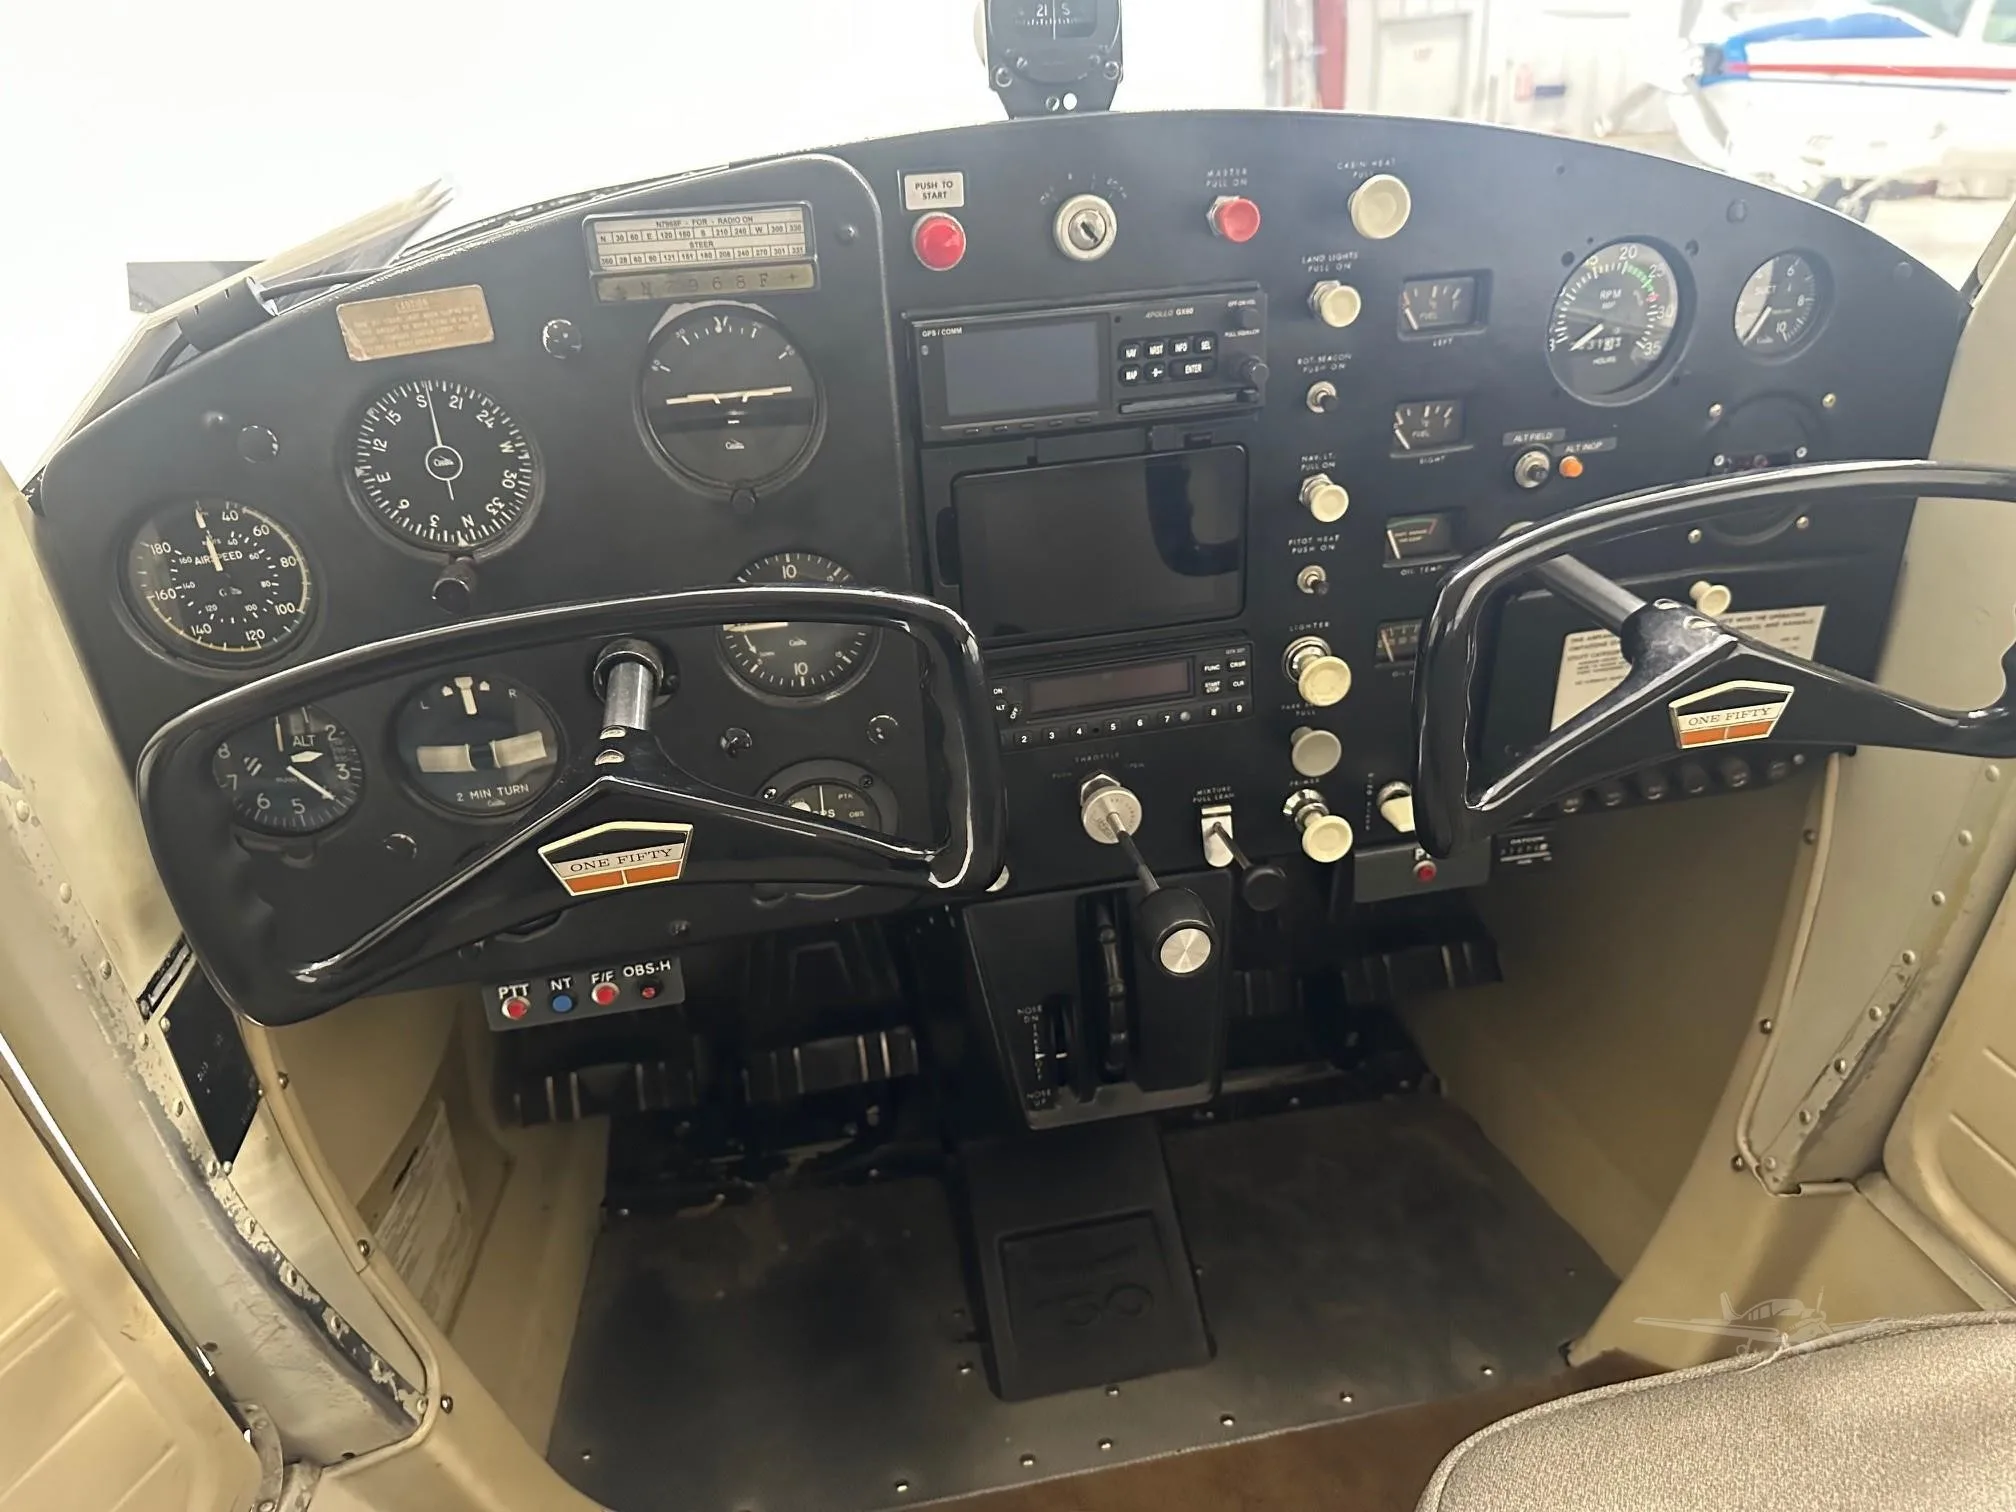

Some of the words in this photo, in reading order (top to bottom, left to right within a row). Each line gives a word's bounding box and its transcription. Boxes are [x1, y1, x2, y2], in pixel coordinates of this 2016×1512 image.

[1037, 4, 1047, 17] 21
[1062, 4, 1070, 15] S
[915, 181, 938, 190] PUSH
[942, 180, 953, 188] TO
[1206, 179, 1227, 188] PULL
[1233, 178, 1248, 186] ON
[923, 191, 947, 200] START
[717, 216, 740, 225] RADIO
[690, 240, 714, 249] STEER
[1302, 254, 1325, 264] LAND
[1329, 252, 1358, 261] LIGHTS
[1619, 247, 1638, 260] 20
[1336, 262, 1351, 270] ON
[1648, 264, 1665, 279] 25
[1787, 265, 1795, 276] 6
[1600, 290, 1621, 300] RPM
[1798, 294, 1804, 306] 8
[1146, 309, 1173, 318] APOLLO
[922, 329, 936, 337] GPS
[942, 327, 962, 335] COMM
[1776, 321, 1787, 333] 10
[1175, 342, 1187, 352] INFO
[1644, 342, 1662, 356] 35
[1185, 364, 1202, 374] ENTER
[416, 395, 427, 407] S
[449, 395, 463, 410] 21
[385, 410, 401, 426] 15
[476, 410, 493, 428] 24
[1513, 433, 1528, 442] ALT
[1530, 432, 1553, 440] FIELD
[372, 438, 387, 452] 12
[500, 440, 514, 453] W
[1565, 444, 1580, 453] ALT
[377, 472, 391, 483] E
[502, 470, 517, 489] 30
[485, 497, 504, 515] 33
[222, 511, 238, 521] 40
[429, 515, 440, 527] 3
[461, 514, 474, 527] N
[253, 525, 270, 535] 60
[150, 542, 171, 554] 180
[1292, 546, 1315, 554] PUSH
[195, 551, 243, 565] AIREED
[280, 557, 297, 567] 80
[782, 565, 797, 579] 10
[155, 588, 177, 600] 160
[274, 603, 296, 615] 100
[191, 624, 212, 635] 140
[245, 629, 265, 641] 120
[794, 662, 808, 675] 10
[1204, 664, 1220, 672] FUNC
[509, 689, 517, 698] R
[420, 702, 430, 710] L
[1689, 715, 1720, 726] ONE
[1725, 708, 1772, 720] FIFTY
[1021, 735, 1027, 743] 2
[1165, 715, 1170, 723] 7
[1237, 704, 1242, 712] 9
[325, 724, 337, 741] 2
[293, 735, 316, 747] ALT
[217, 743, 230, 759] 8
[336, 763, 350, 780] 3
[226, 774, 237, 791] 7
[456, 792, 463, 801] 2
[470, 789, 491, 800] MIN
[497, 784, 529, 796] TURN
[257, 793, 271, 809] 6
[291, 798, 305, 814] 5
[570, 858, 610, 872] ONE
[617, 849, 672, 864] FIFTY
[499, 983, 529, 999] PTT
[551, 977, 572, 991] NT
[591, 971, 614, 984] F/F
